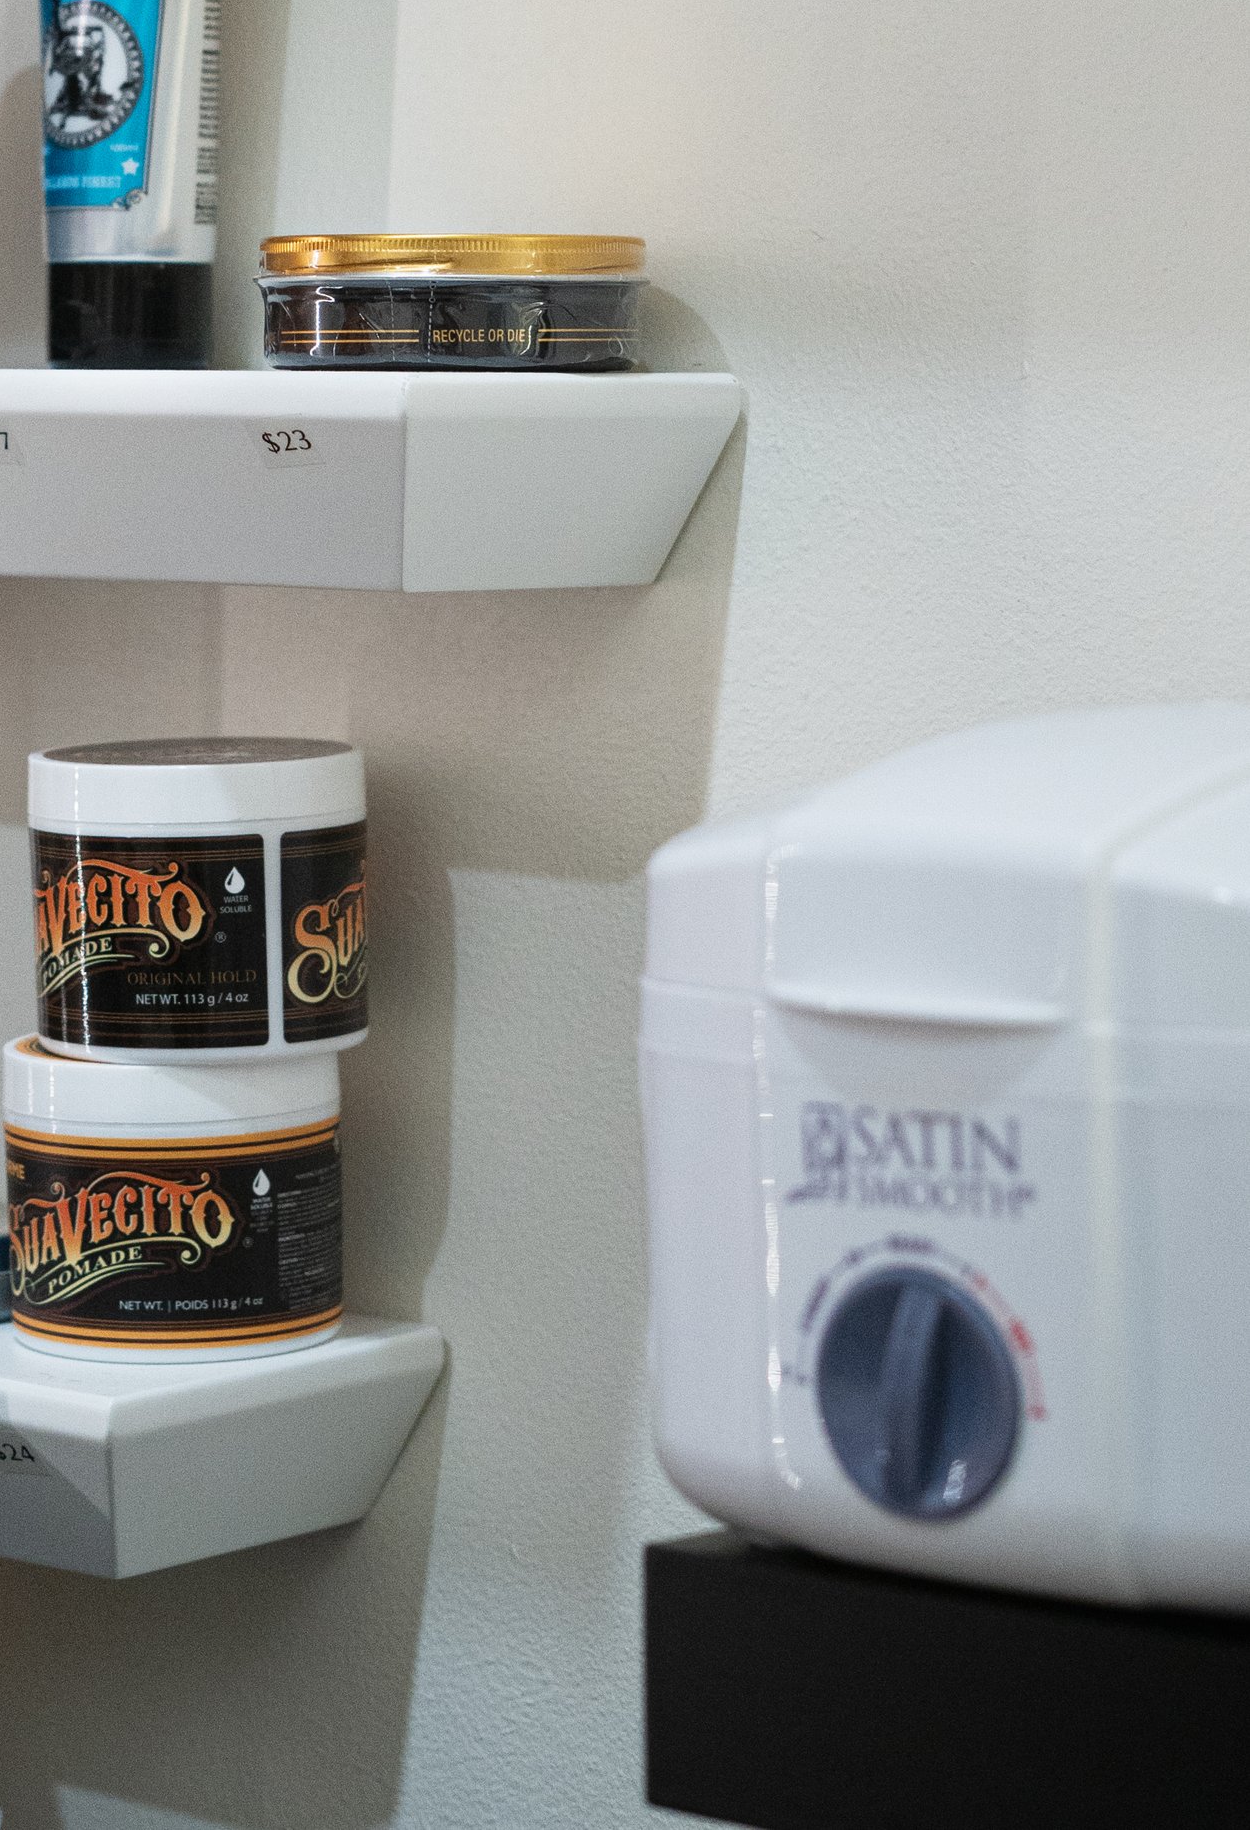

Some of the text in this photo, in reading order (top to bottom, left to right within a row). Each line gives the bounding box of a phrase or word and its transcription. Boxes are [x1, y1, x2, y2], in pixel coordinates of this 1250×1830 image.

[432, 328, 527, 343] RECYCLE OR DIE
[261, 428, 313, 454] $23
[223, 894, 250, 904] WATER
[219, 905, 253, 915] SOLUBLE
[127, 969, 258, 986] ORIGINAL HOLD
[135, 993, 158, 1005] NET
[159, 993, 182, 1005] WT.
[184, 993, 205, 1005] 113
[225, 992, 233, 1003] 4
[235, 993, 250, 1003] oz
[48, 1245, 143, 1295] POMADE
[118, 1300, 141, 1311] NET
[143, 1300, 164, 1311] WT.
[175, 1299, 209, 1311] POIDS
